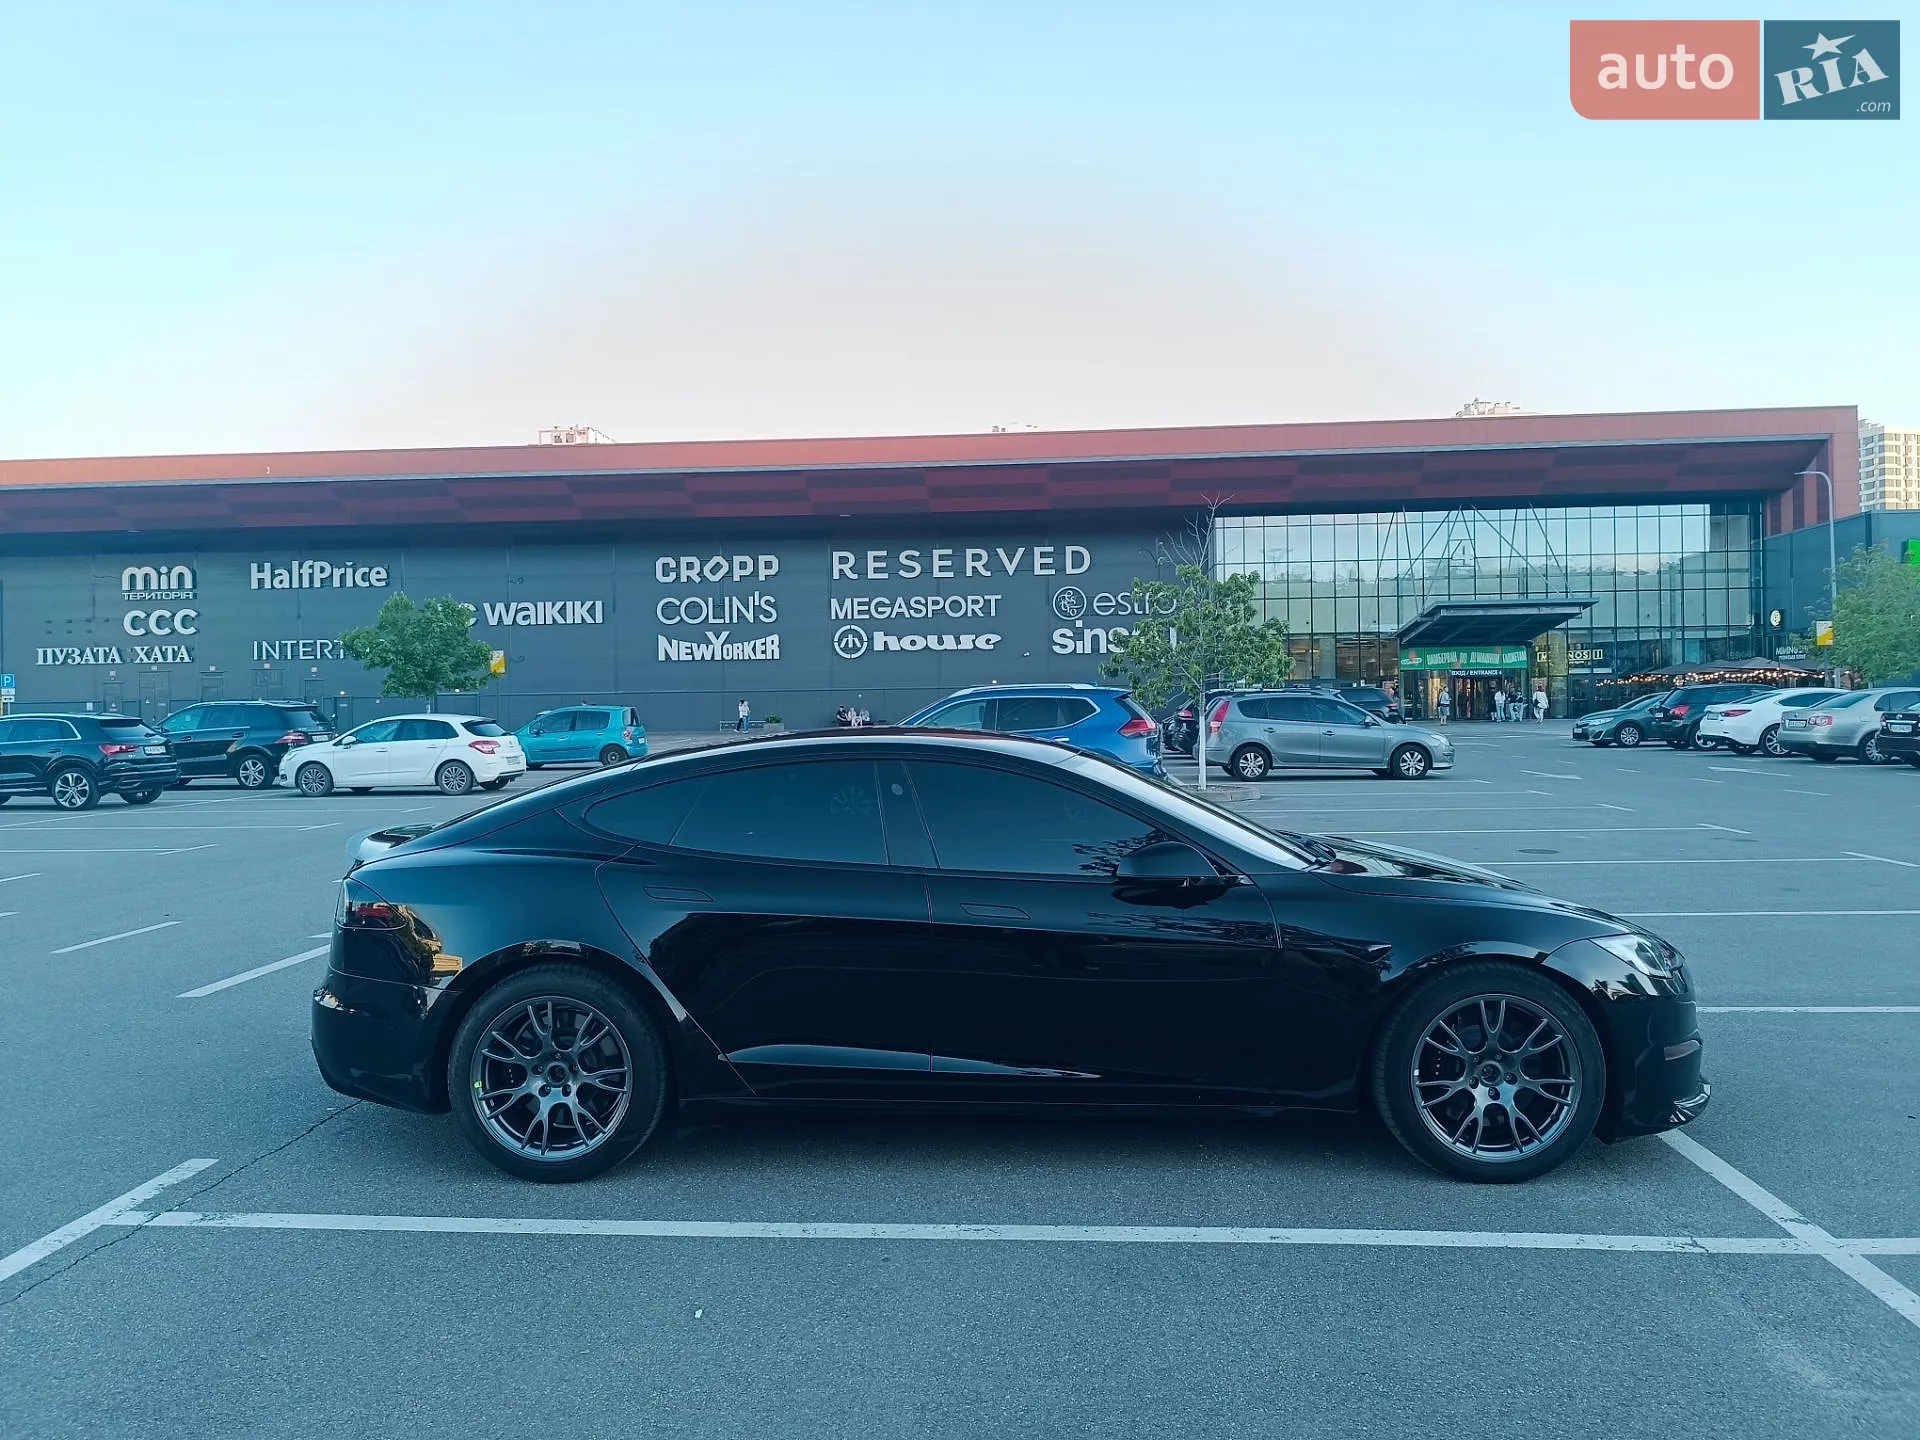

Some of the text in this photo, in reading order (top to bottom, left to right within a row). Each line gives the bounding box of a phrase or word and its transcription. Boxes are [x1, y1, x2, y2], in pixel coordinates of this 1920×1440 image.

[250, 559, 388, 590] HalfPrice
[655, 554, 779, 583] CROPP
[832, 545, 1091, 580] RESERVED
[656, 591, 777, 625] COLIN'S
[830, 594, 1002, 620] MEGASPORT
[123, 608, 198, 636] CCC
[252, 639, 346, 660] INTERT
[873, 631, 1002, 651] house
[1052, 620, 1177, 655] sins
[35, 645, 192, 665] ПУЗАТА ХАТА
